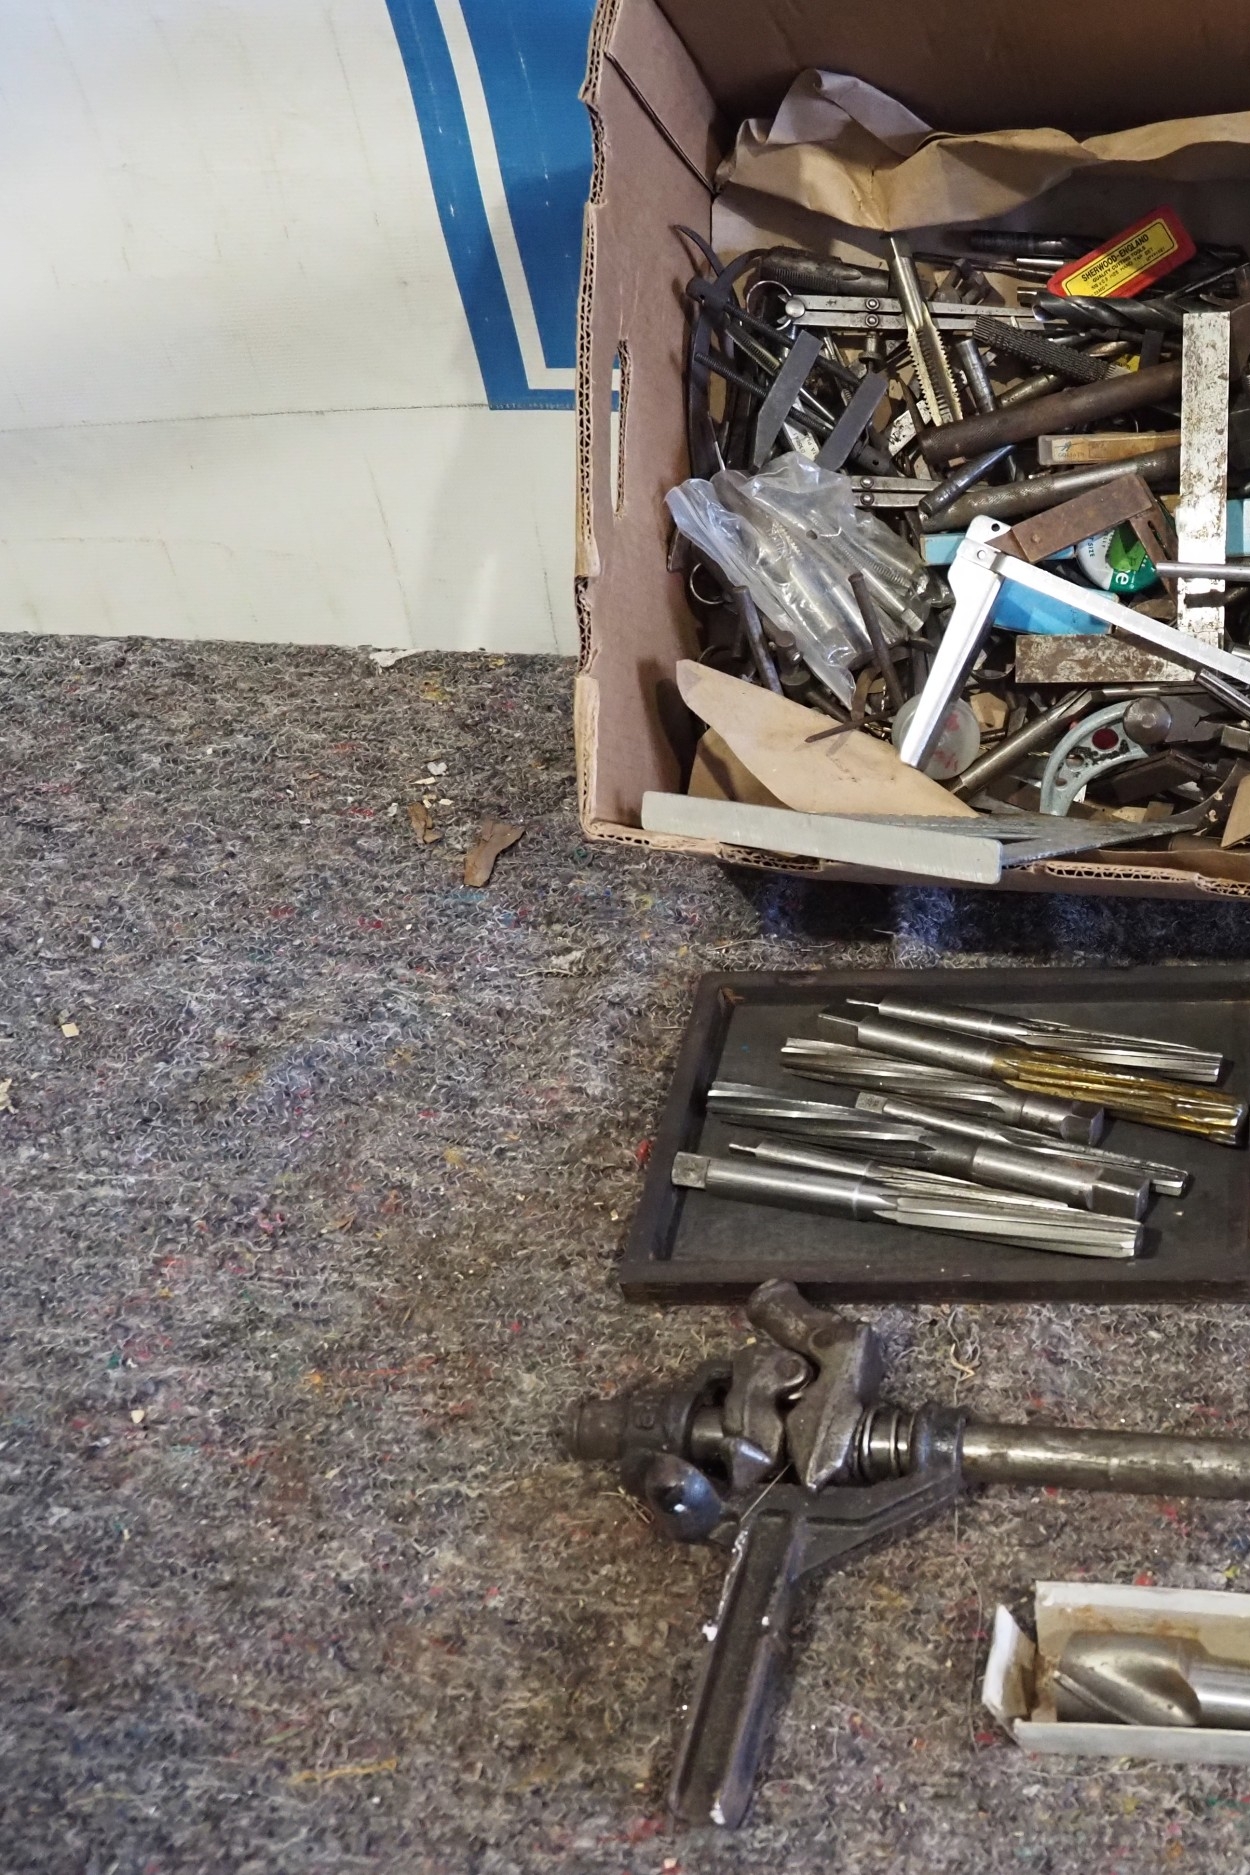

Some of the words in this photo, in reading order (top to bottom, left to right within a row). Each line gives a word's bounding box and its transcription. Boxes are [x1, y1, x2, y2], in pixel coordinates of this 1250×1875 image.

[1081, 233, 1149, 282] SHERWOOD-ENGLAND
[1092, 268, 1112, 282] QUALITY
[1111, 255, 1132, 271] CUTTING
[1132, 246, 1146, 257] TOOLS
[1087, 542, 1096, 558] SIZE
